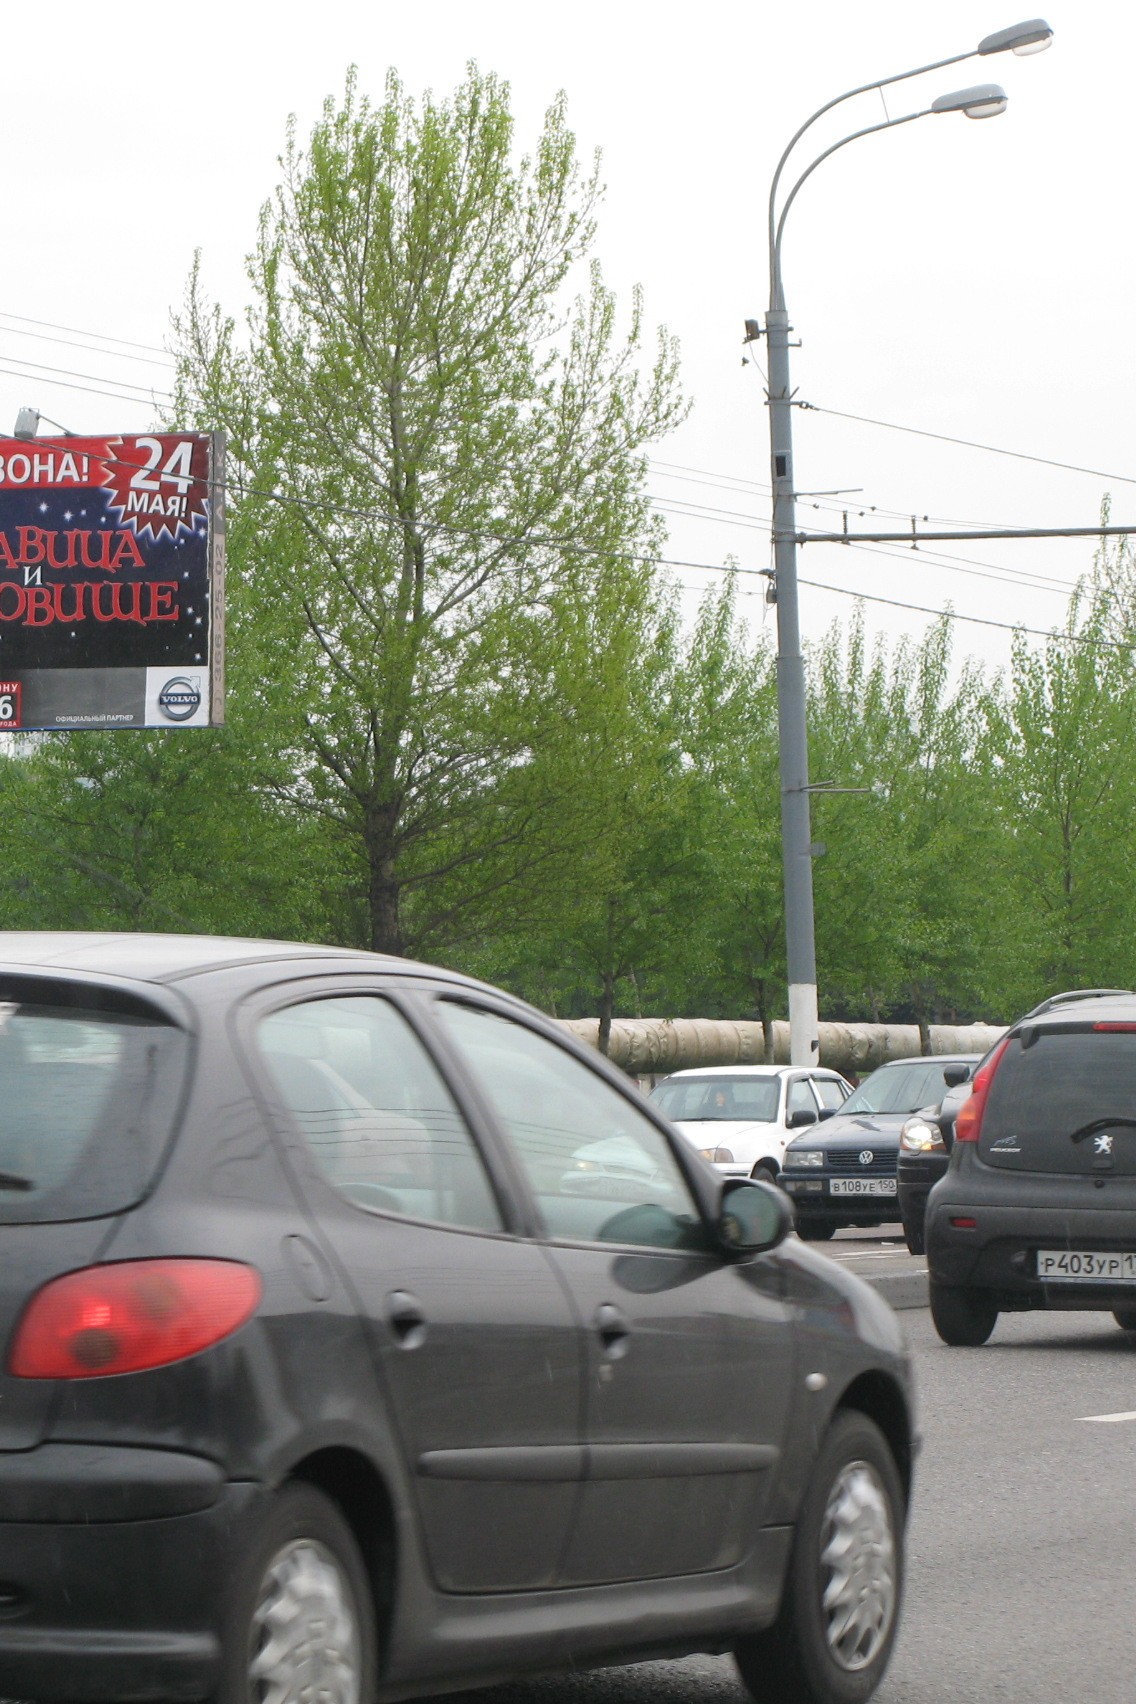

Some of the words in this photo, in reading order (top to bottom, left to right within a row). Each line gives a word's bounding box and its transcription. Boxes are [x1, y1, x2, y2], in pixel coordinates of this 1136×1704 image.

[130, 437, 194, 494] 24
[127, 491, 188, 517] МАЯ!
[162, 695, 198, 703] VOLVO
[1044, 1254, 1120, 1275] Р403УР
[1124, 1254, 1136, 1270] 1
